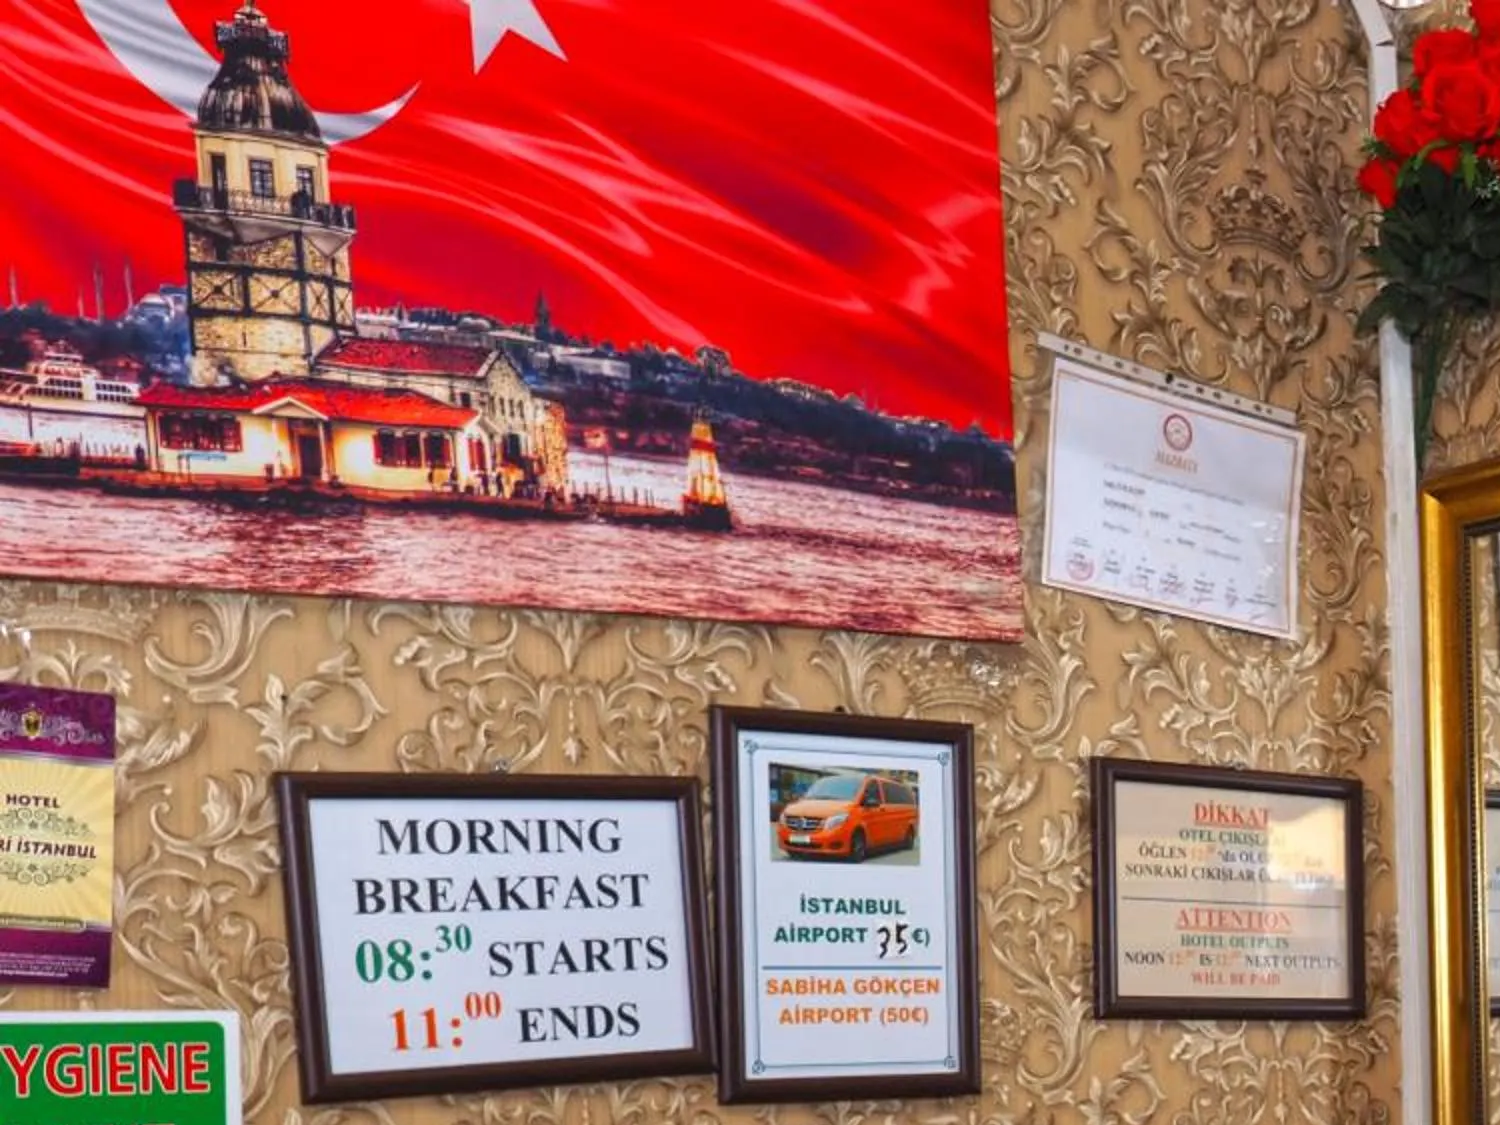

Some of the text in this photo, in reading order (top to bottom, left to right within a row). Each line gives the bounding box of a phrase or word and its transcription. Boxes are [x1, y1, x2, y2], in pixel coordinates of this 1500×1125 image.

[6, 793, 61, 810] HOTEL
[16, 836, 97, 860] İSTANBUL
[377, 816, 623, 856] MORNING
[354, 872, 650, 915] BREAKFAST
[798, 892, 906, 917] İSTANBUL
[1177, 907, 1293, 928] ATTENTION
[774, 921, 868, 945] AİRPORT
[488, 935, 669, 979] STARTS
[1124, 950, 1166, 966] NOON
[766, 975, 941, 999] SABİHA GÖKÇEN
[518, 1002, 641, 1044] ENDS
[779, 1004, 930, 1027] AİRPORT (50€)
[0, 1042, 211, 1098] YGIENE
